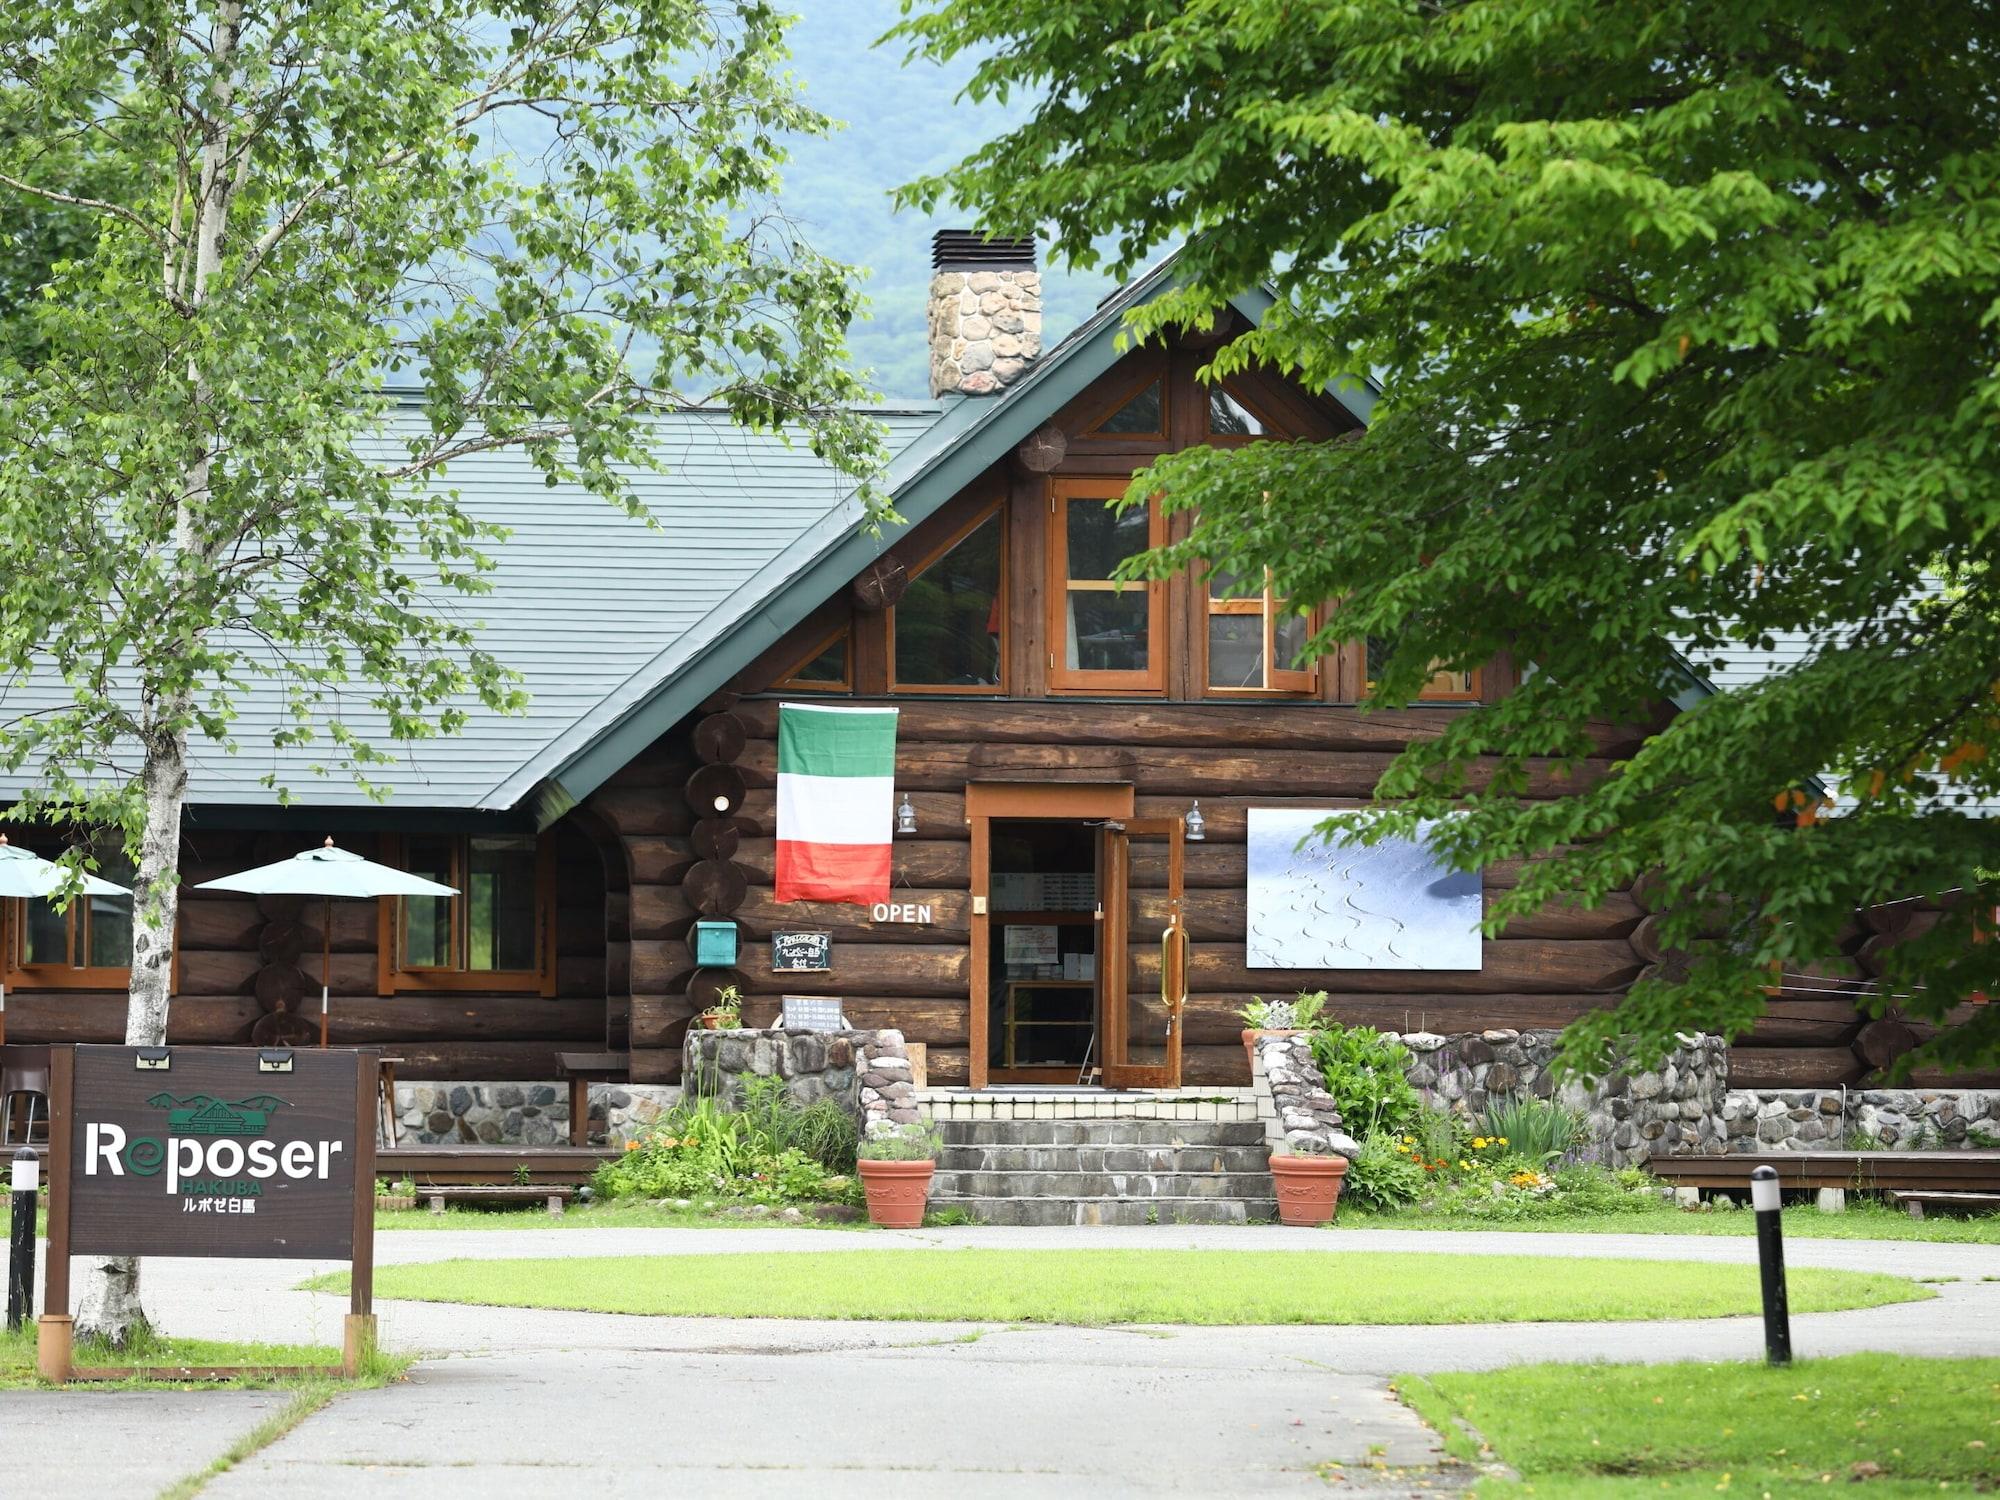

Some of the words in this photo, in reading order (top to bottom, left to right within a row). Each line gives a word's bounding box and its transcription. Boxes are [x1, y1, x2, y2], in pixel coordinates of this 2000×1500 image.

[873, 903, 931, 923] OPEN
[85, 1122, 343, 1195] Reposer
[180, 1180, 263, 1196] HAKUBA
[183, 1197, 256, 1214] ルポゼ白馬
